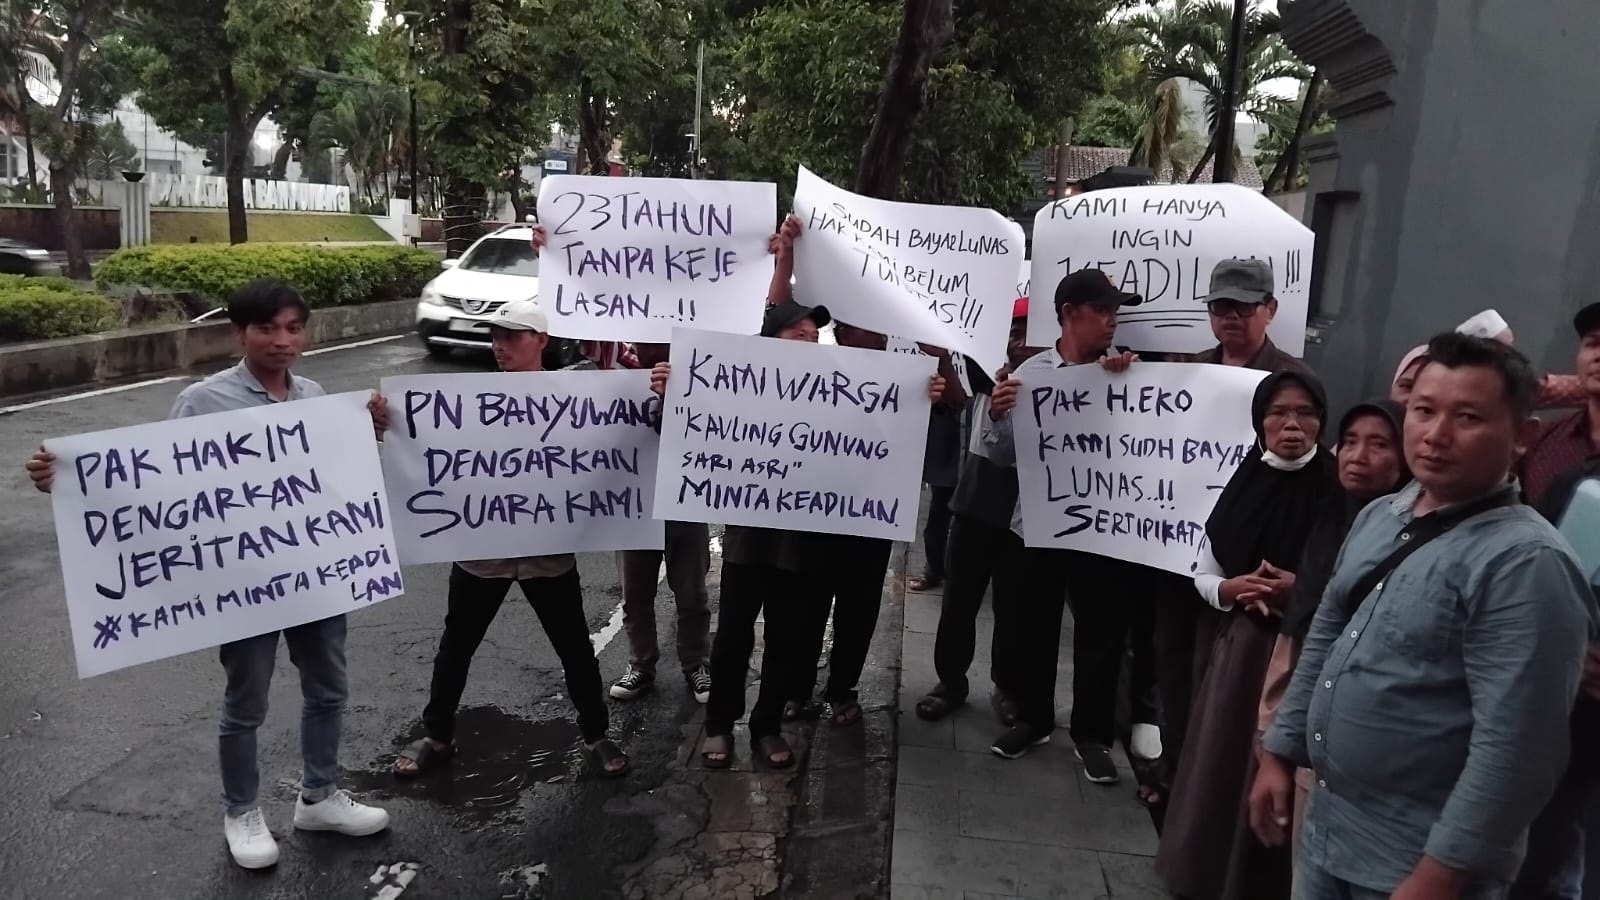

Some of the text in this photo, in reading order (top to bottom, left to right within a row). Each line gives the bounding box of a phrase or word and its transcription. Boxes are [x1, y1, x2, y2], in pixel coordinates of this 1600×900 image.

[553, 192, 732, 237] 23 TAHUN
[1050, 197, 1227, 222] KAMI HANYA
[1112, 228, 1193, 251] INGIN
[561, 241, 737, 283] TANPA KEJE
[903, 265, 970, 297] BELUM
[683, 348, 900, 413] KAMI WARGA
[404, 389, 463, 439] PN
[1032, 386, 1092, 429] PAK
[75, 419, 311, 496] PAK HAKIM
[423, 446, 639, 487] DENGARKAN
[681, 451, 733, 473] SARI
[1038, 430, 1112, 462] KAMI
[1119, 434, 1174, 460] SUDH
[84, 467, 322, 547] DENGARKAN
[405, 489, 556, 538] SUARA
[676, 475, 770, 511] MINTA
[1053, 504, 1203, 548] SERTIPIKAT
[216, 572, 311, 614] MINTA
[350, 572, 403, 602] LAN
